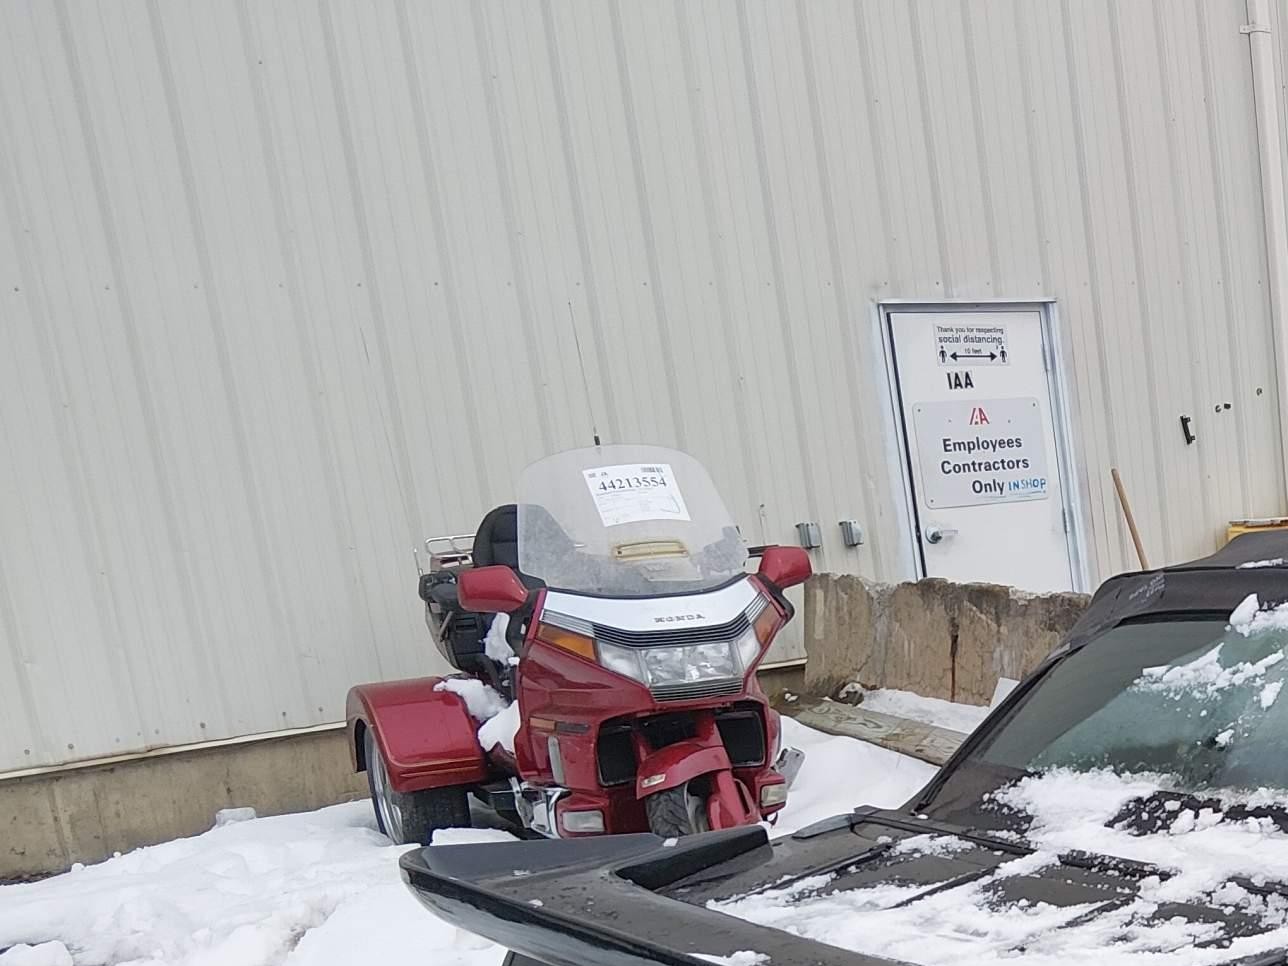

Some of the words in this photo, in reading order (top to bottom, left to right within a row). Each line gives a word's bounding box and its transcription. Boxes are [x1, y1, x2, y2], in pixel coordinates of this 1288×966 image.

[938, 335, 961, 344] social
[947, 371, 974, 390] IAA
[942, 436, 1023, 454] Employees
[941, 458, 1030, 475] Contractors
[598, 475, 668, 491] 44213554
[972, 479, 1005, 495] Only
[653, 613, 706, 623] HONDA
